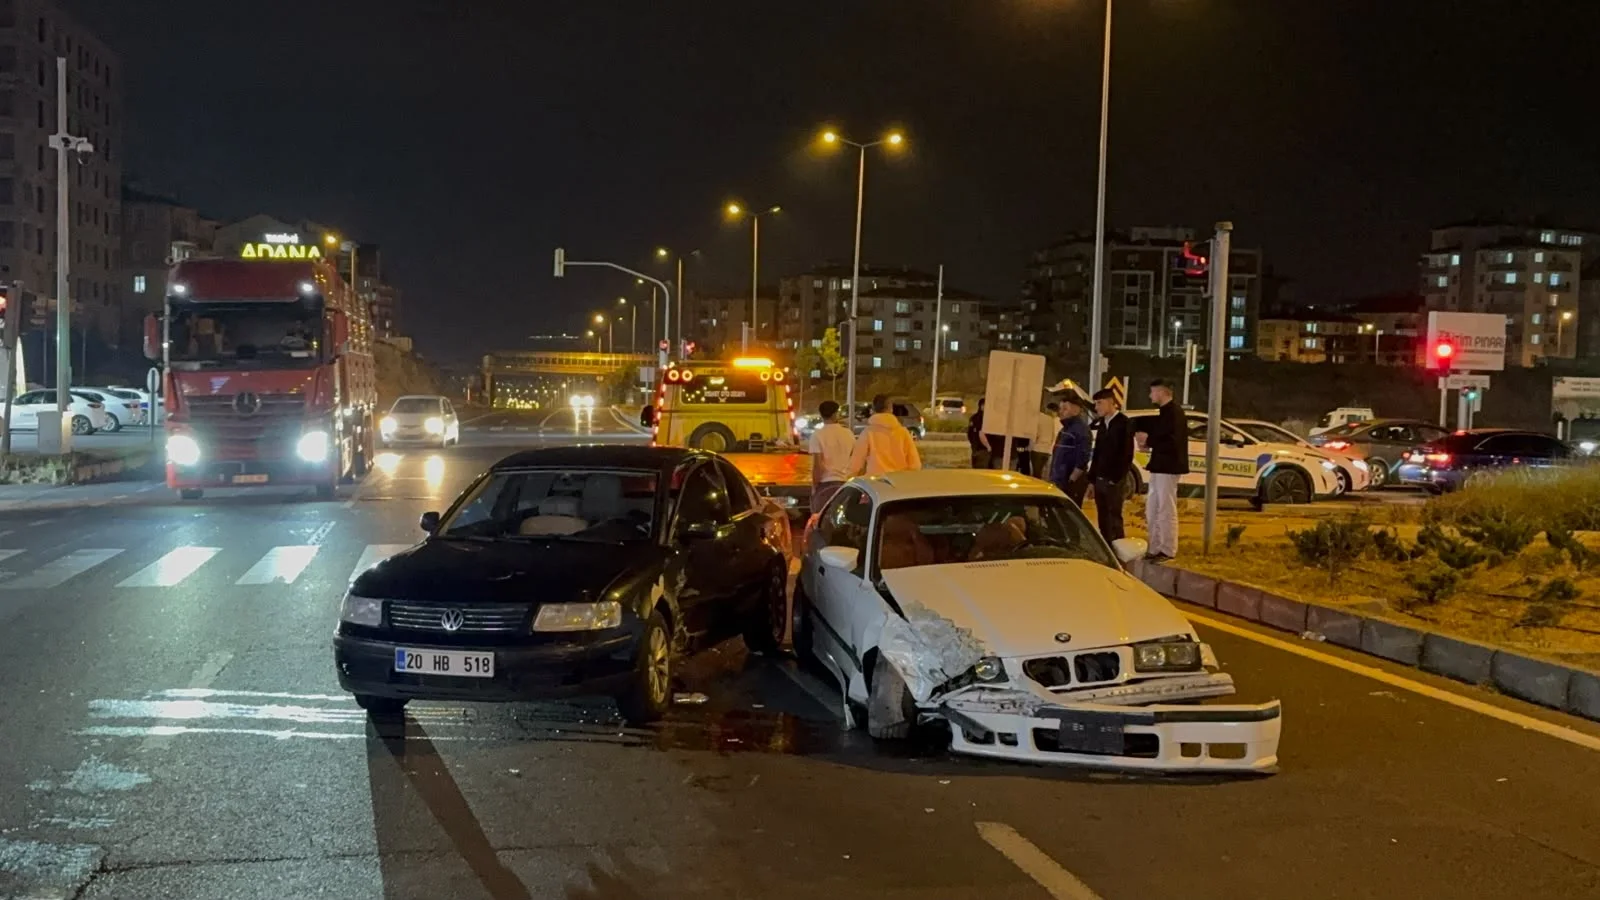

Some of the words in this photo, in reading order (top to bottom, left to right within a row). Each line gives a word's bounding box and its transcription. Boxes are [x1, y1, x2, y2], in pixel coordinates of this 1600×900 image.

[241, 243, 321, 258] ADANA
[1222, 463, 1251, 473] POLİSİ
[407, 653, 423, 669] 20
[433, 655, 450, 671] HB
[464, 657, 490, 673] 518
